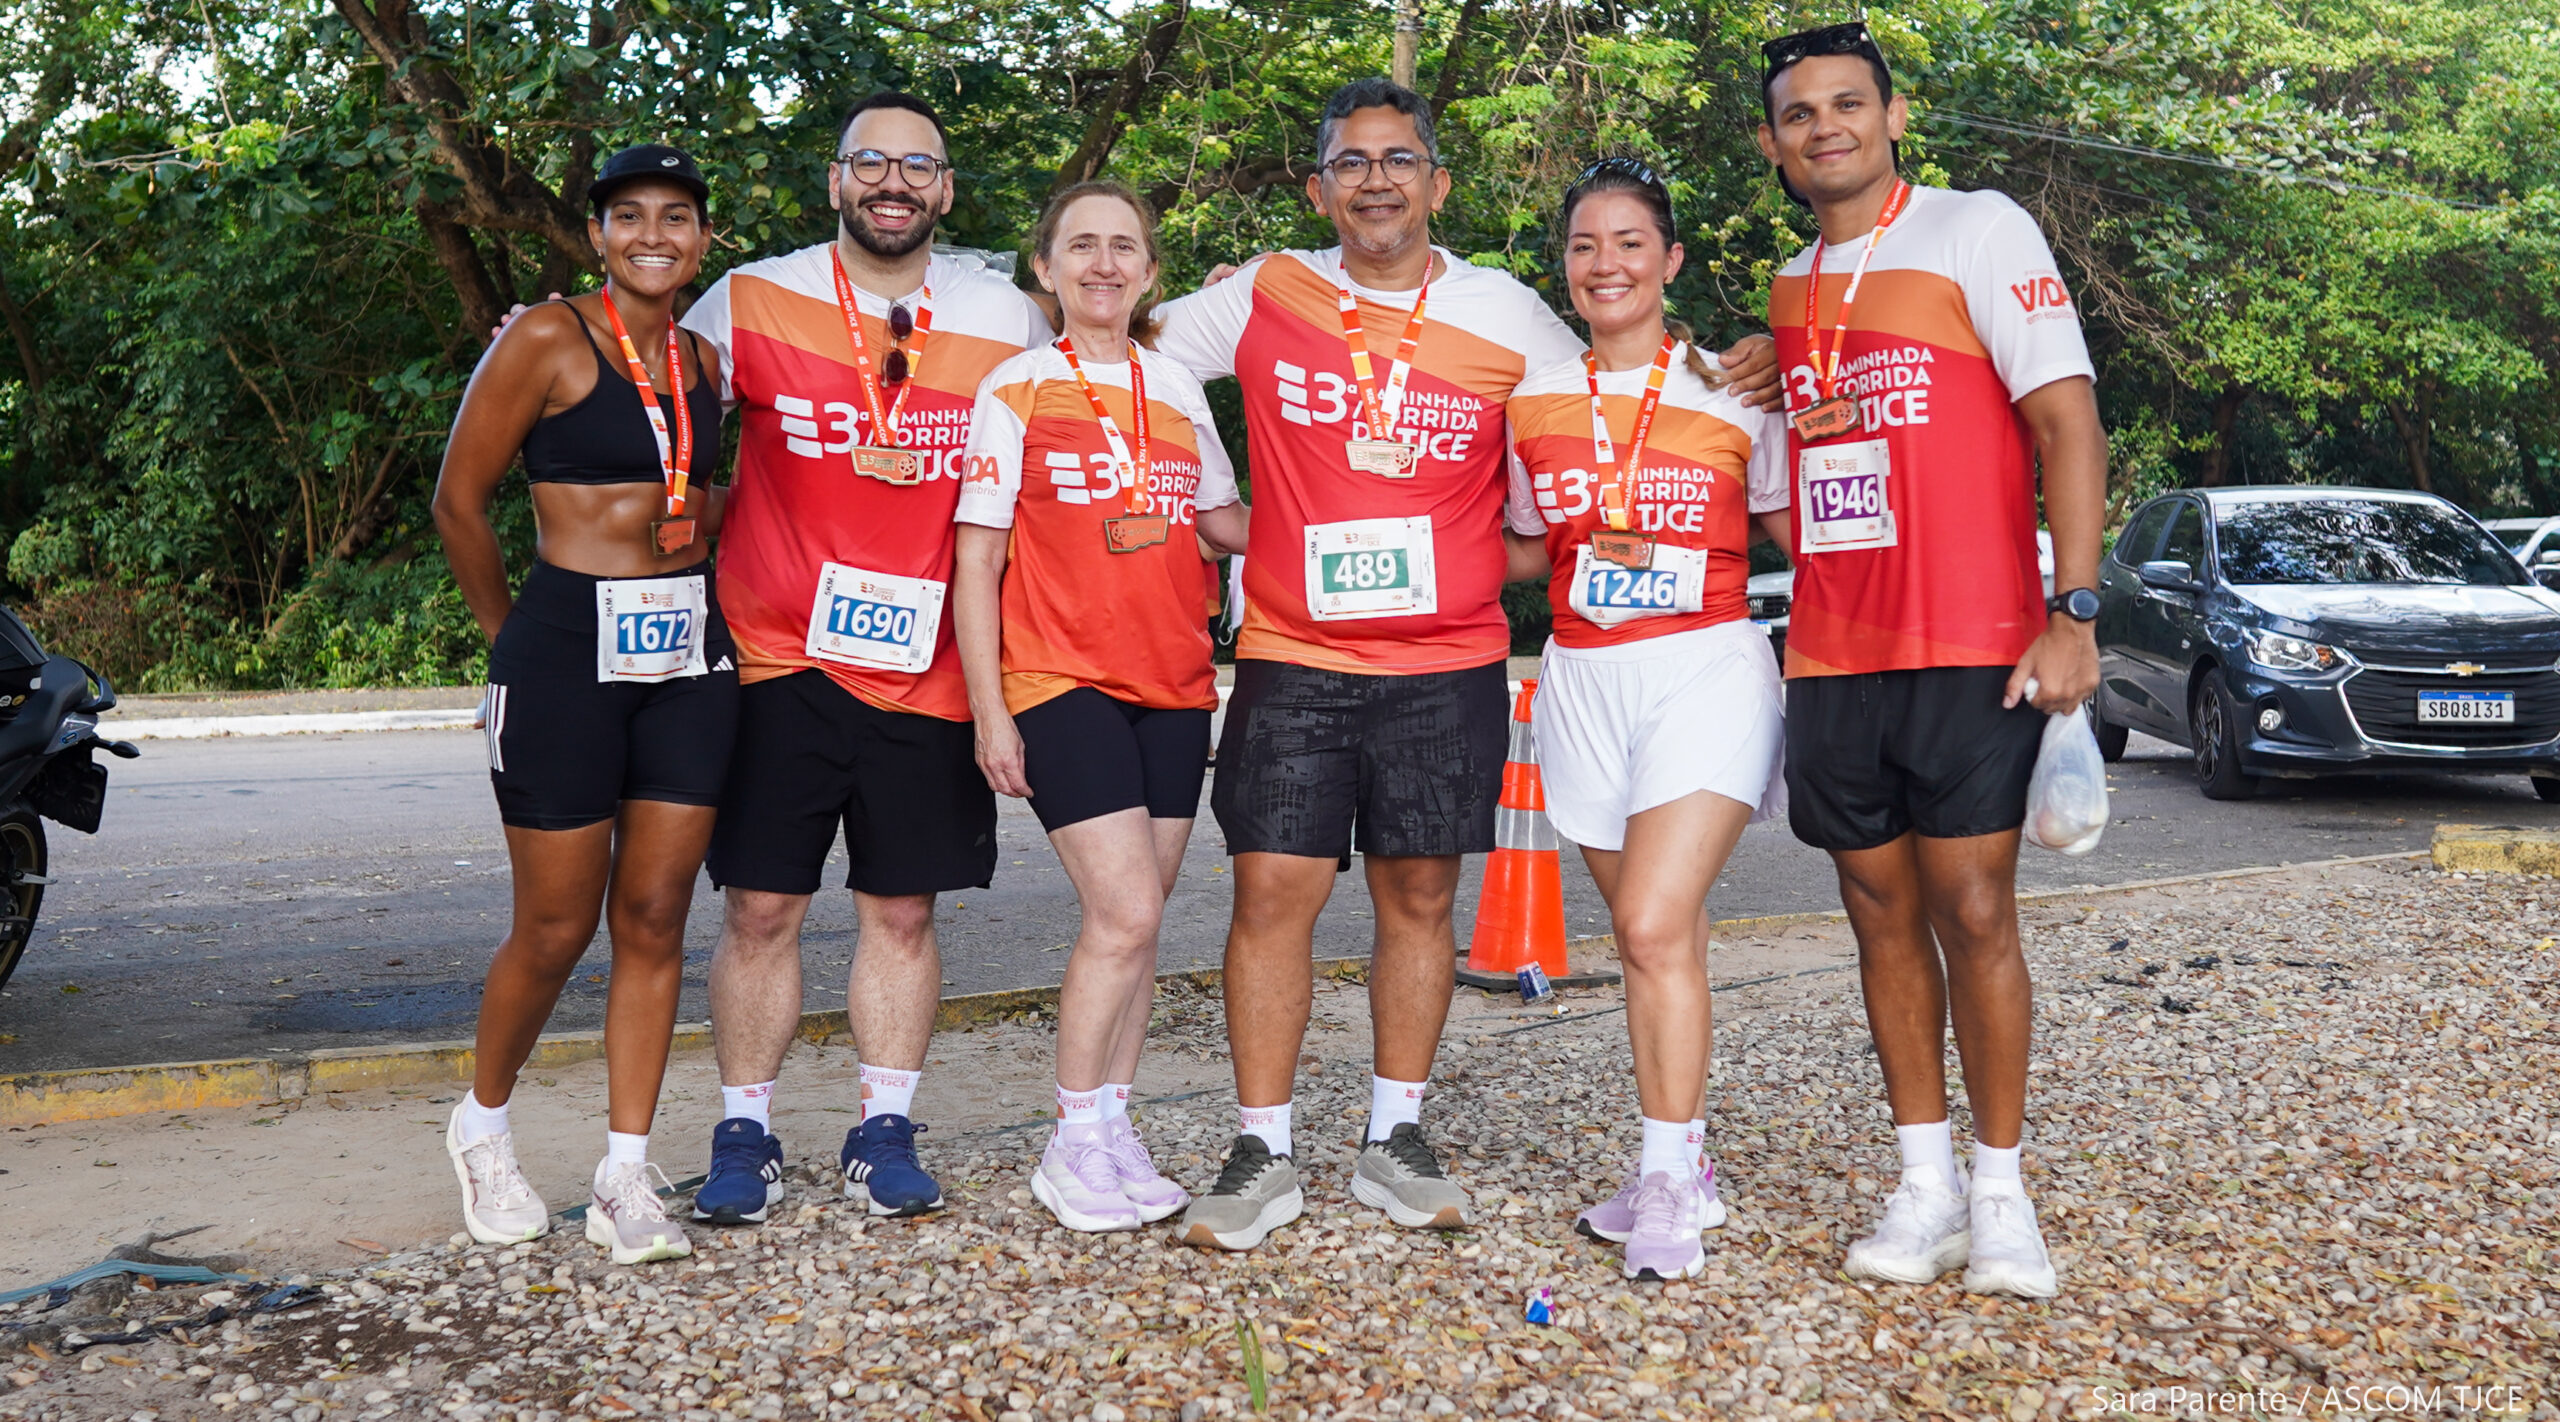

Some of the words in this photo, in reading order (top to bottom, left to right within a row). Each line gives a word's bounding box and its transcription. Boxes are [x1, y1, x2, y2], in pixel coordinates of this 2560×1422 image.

[1836, 347, 1935, 379] AMINHADA
[1377, 388, 1483, 412] AINHADA
[1859, 389, 1930, 434] TJCE
[900, 408, 974, 426] MINHA
[1396, 427, 1474, 462] TJCE
[910, 447, 964, 482] TJC
[1089, 453, 1120, 500] 3
[1150, 459, 1203, 478] MINHA
[1616, 467, 1716, 484] INHADA
[1147, 474, 1198, 495] ORRID
[1812, 476, 1879, 519] 1946
[1156, 495, 1197, 526] TJC
[1635, 503, 1706, 533] TJCE
[1334, 551, 1397, 589] 489
[824, 576, 835, 597] 5KM
[1591, 570, 1675, 607] 1246
[605, 597, 614, 618] 5KM
[834, 598, 914, 643] 1690
[619, 611, 691, 652] 1672
